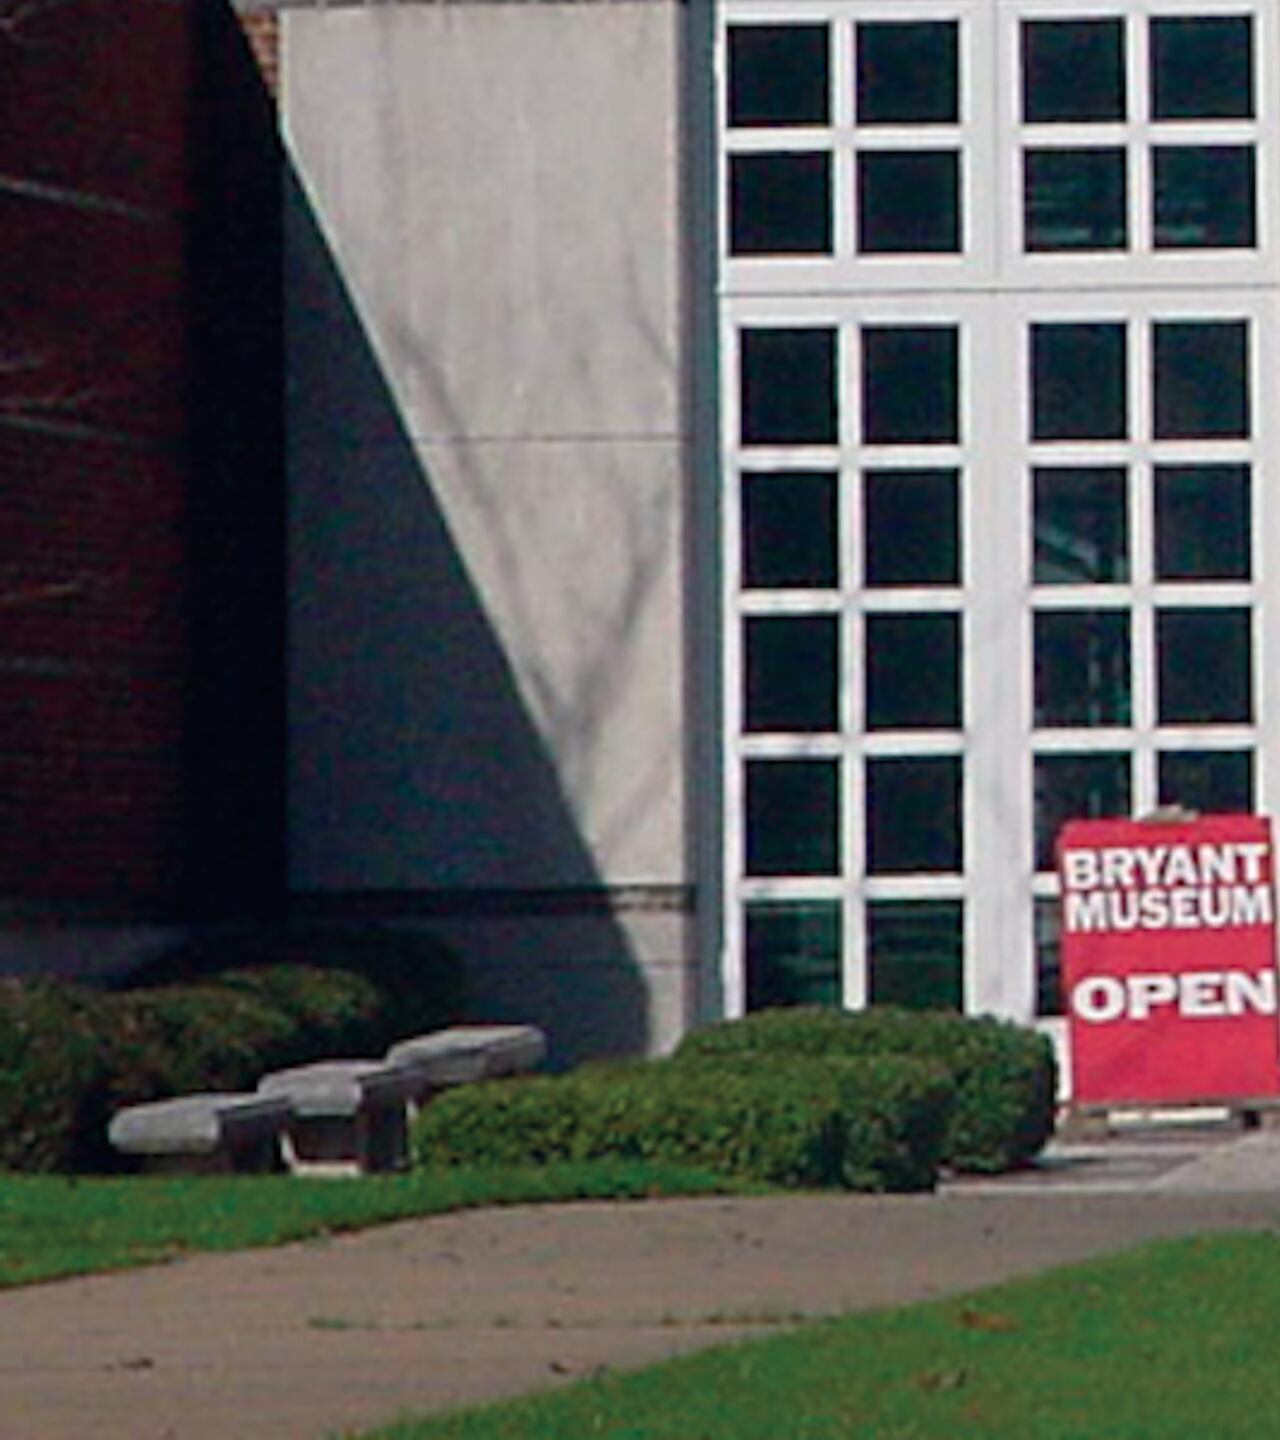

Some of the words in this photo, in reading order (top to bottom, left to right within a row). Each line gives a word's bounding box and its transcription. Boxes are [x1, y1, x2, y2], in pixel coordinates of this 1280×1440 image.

[1063, 842, 1270, 890] BRYANT
[1066, 886, 1273, 933] MUSEUM
[1073, 971, 1278, 1022] OPEN
